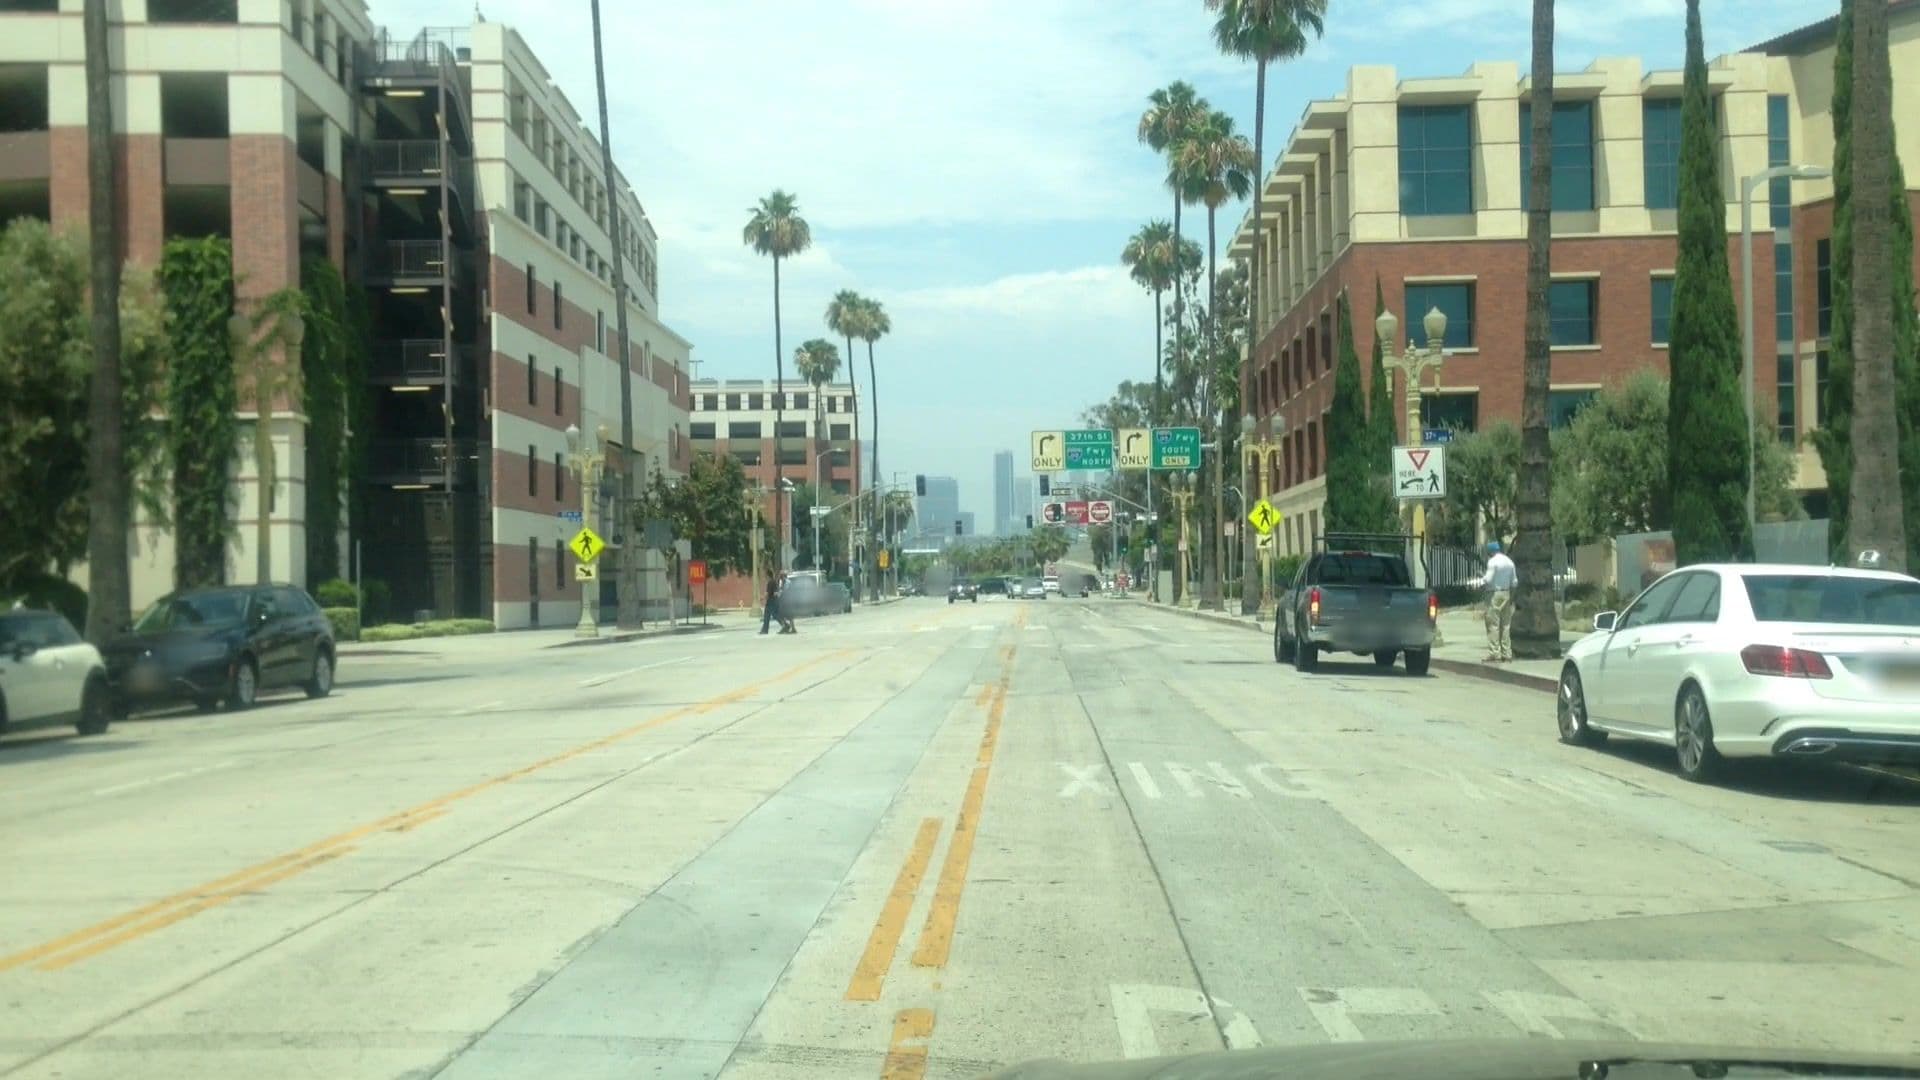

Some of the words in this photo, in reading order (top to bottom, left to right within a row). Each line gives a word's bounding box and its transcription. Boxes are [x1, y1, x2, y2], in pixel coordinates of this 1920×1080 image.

[1086, 447, 1106, 457] Fwy
[1161, 446, 1190, 454] SOUTH
[1033, 457, 1062, 468] ONLY
[1121, 455, 1149, 465] ONLY
[1415, 484, 1425, 492] TO
[1055, 762, 1326, 800] XING
